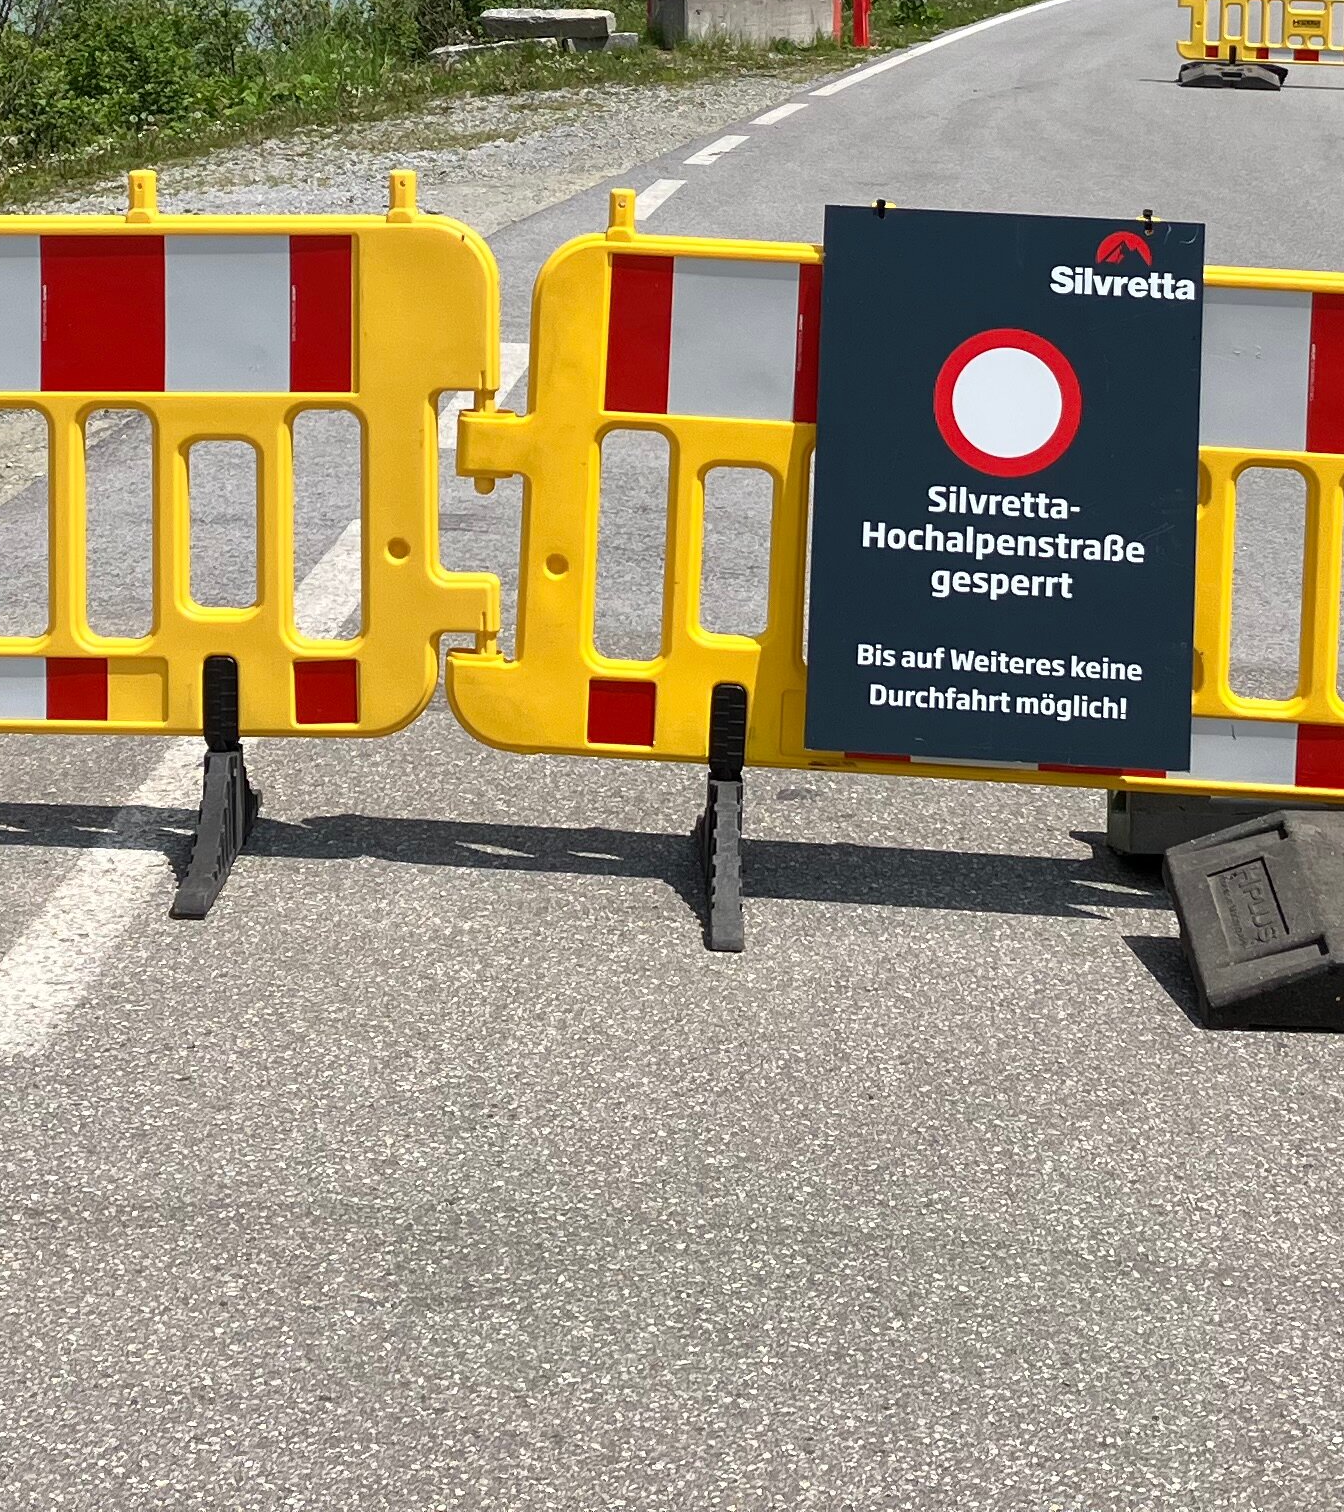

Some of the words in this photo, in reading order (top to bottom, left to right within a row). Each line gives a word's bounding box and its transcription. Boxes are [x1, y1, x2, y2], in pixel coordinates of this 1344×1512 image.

[1050, 265, 1196, 301] Silvretta
[927, 485, 1081, 520] Silvretta-
[862, 521, 1145, 563] Hochalpenstraße
[931, 570, 1073, 601] gesperrt
[857, 643, 896, 667] Bis
[900, 647, 946, 670] auf
[950, 648, 1066, 677] Weiteres
[1070, 655, 1143, 682] keine
[869, 683, 1011, 713] Durchfahrt
[1015, 692, 1127, 722] möglich!
